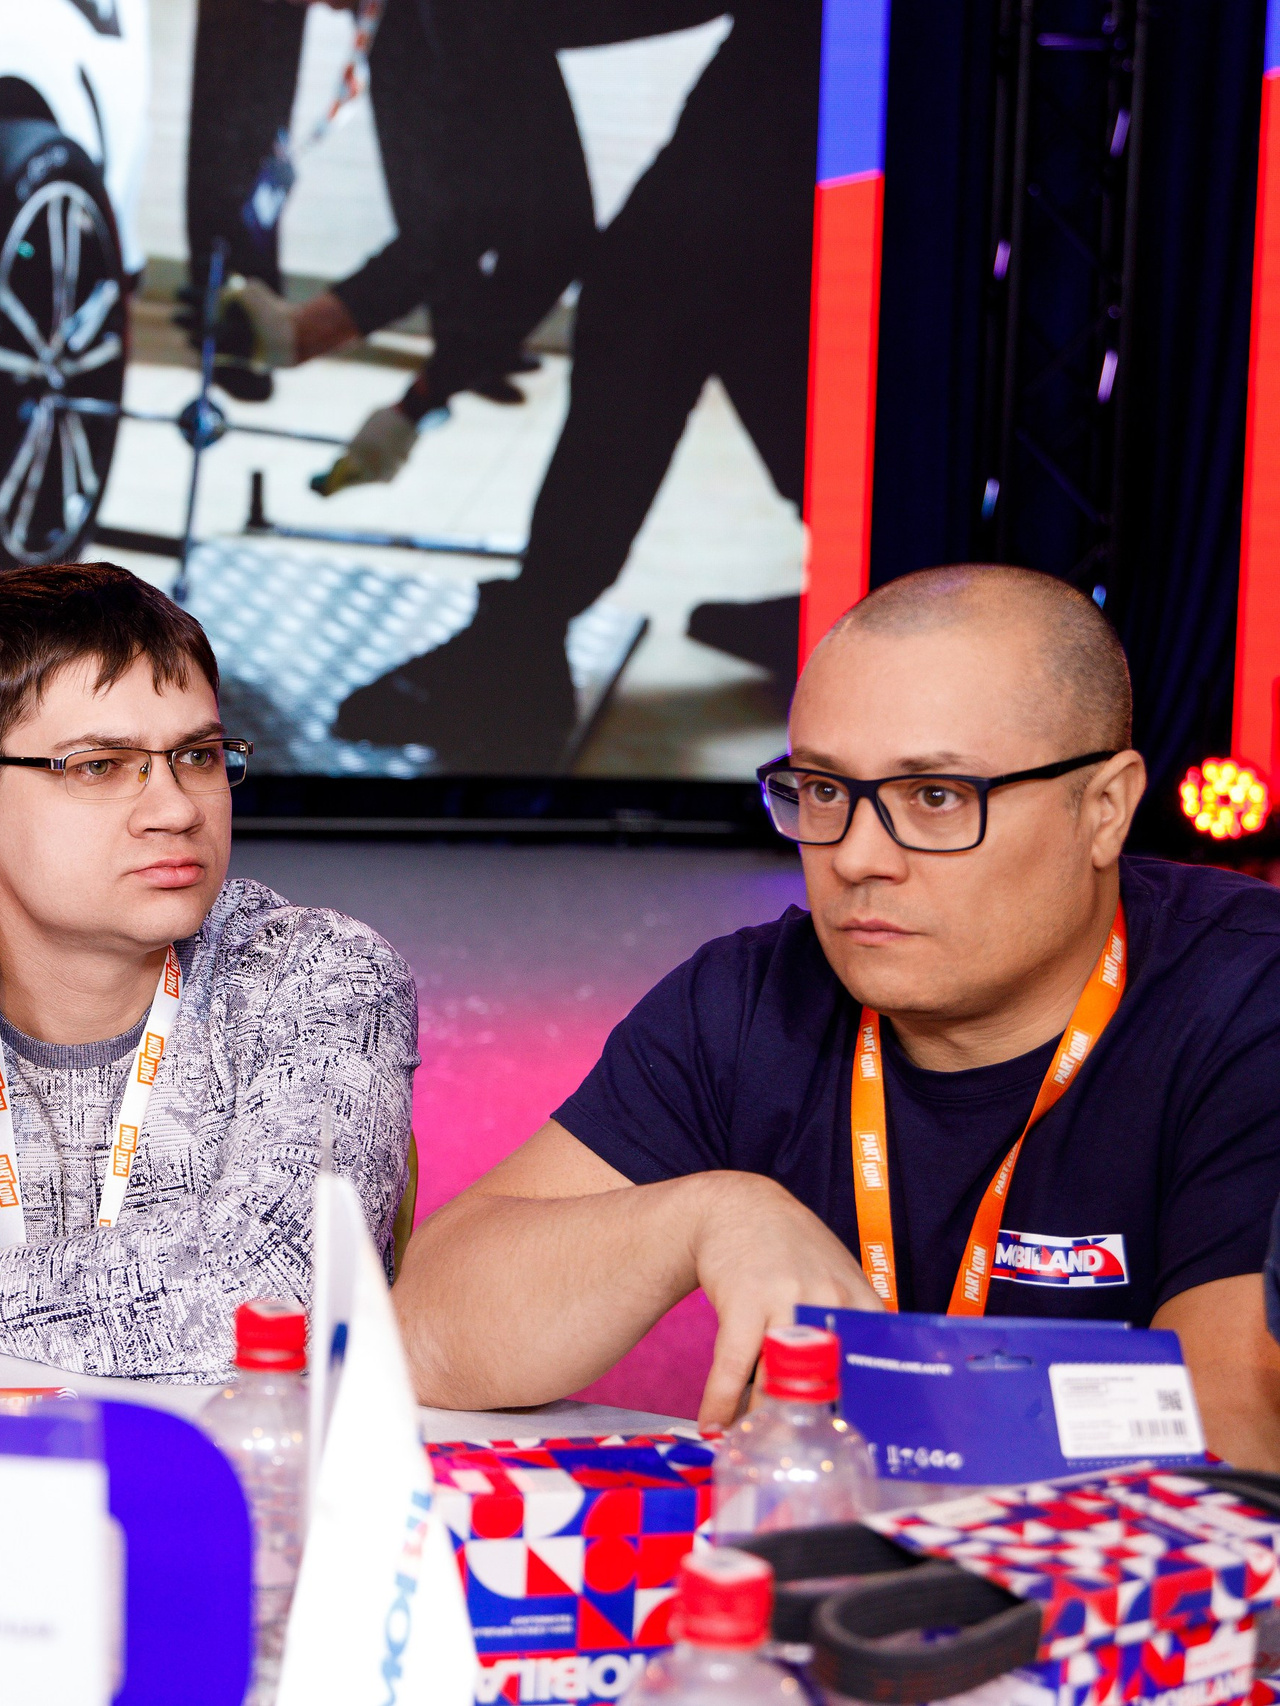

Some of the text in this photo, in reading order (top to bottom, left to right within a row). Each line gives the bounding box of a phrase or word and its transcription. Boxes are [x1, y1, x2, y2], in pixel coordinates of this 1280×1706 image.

[165, 966, 178, 996] PART
[1102, 934, 1123, 988] PART KOM
[139, 1035, 163, 1085] PART KOM
[860, 1026, 876, 1079] PART KOM
[1053, 1030, 1090, 1085] PART KOM
[116, 1125, 136, 1176] PART KOM
[859, 1133, 883, 1189] PART KOM
[994, 1164, 1010, 1196] PART
[868, 1244, 891, 1300] PART KOM
[964, 1244, 987, 1303] PART KOM
[475, 1652, 647, 1705] OBILA
